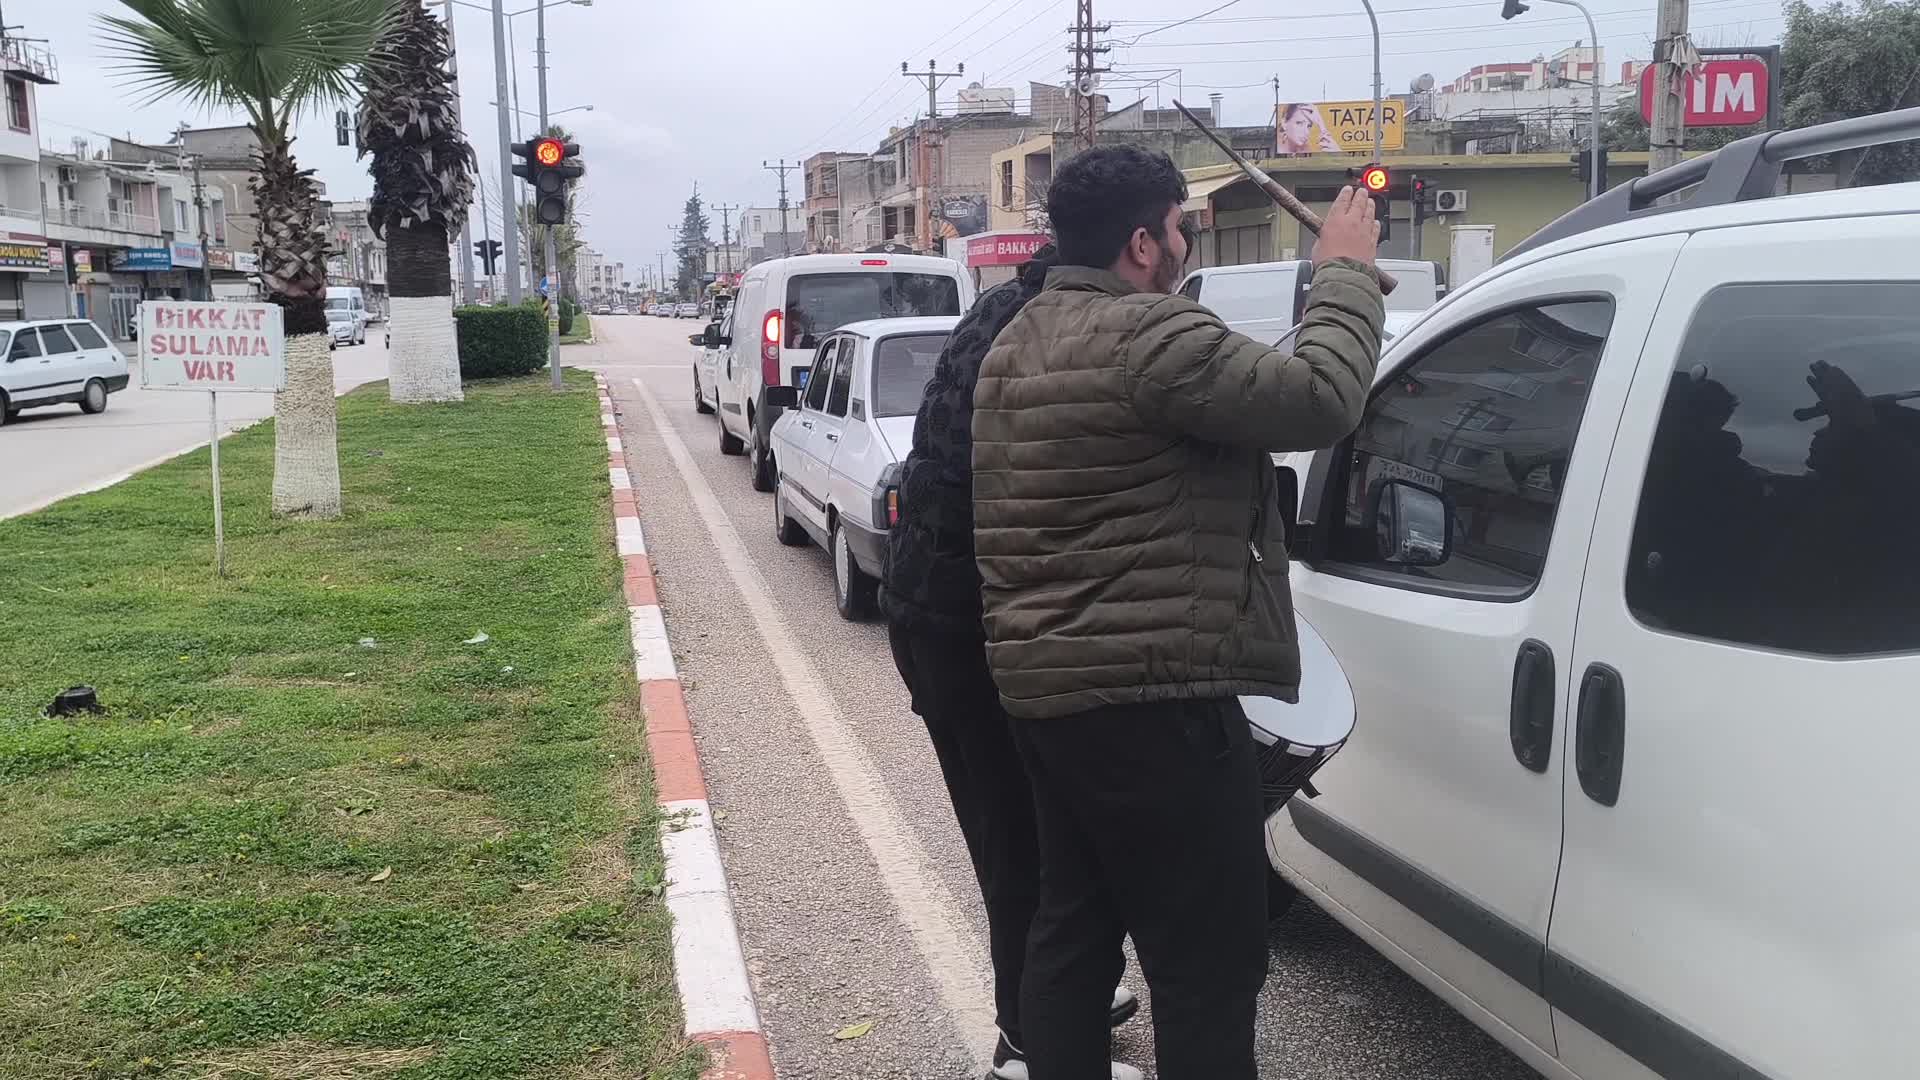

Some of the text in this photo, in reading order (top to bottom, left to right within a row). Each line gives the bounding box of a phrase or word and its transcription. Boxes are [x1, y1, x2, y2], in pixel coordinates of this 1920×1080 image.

[1683, 72, 1756, 113] IM
[1329, 107, 1396, 126] TATAR
[151, 334, 270, 357] SULAMA
[183, 359, 236, 382] VAR
